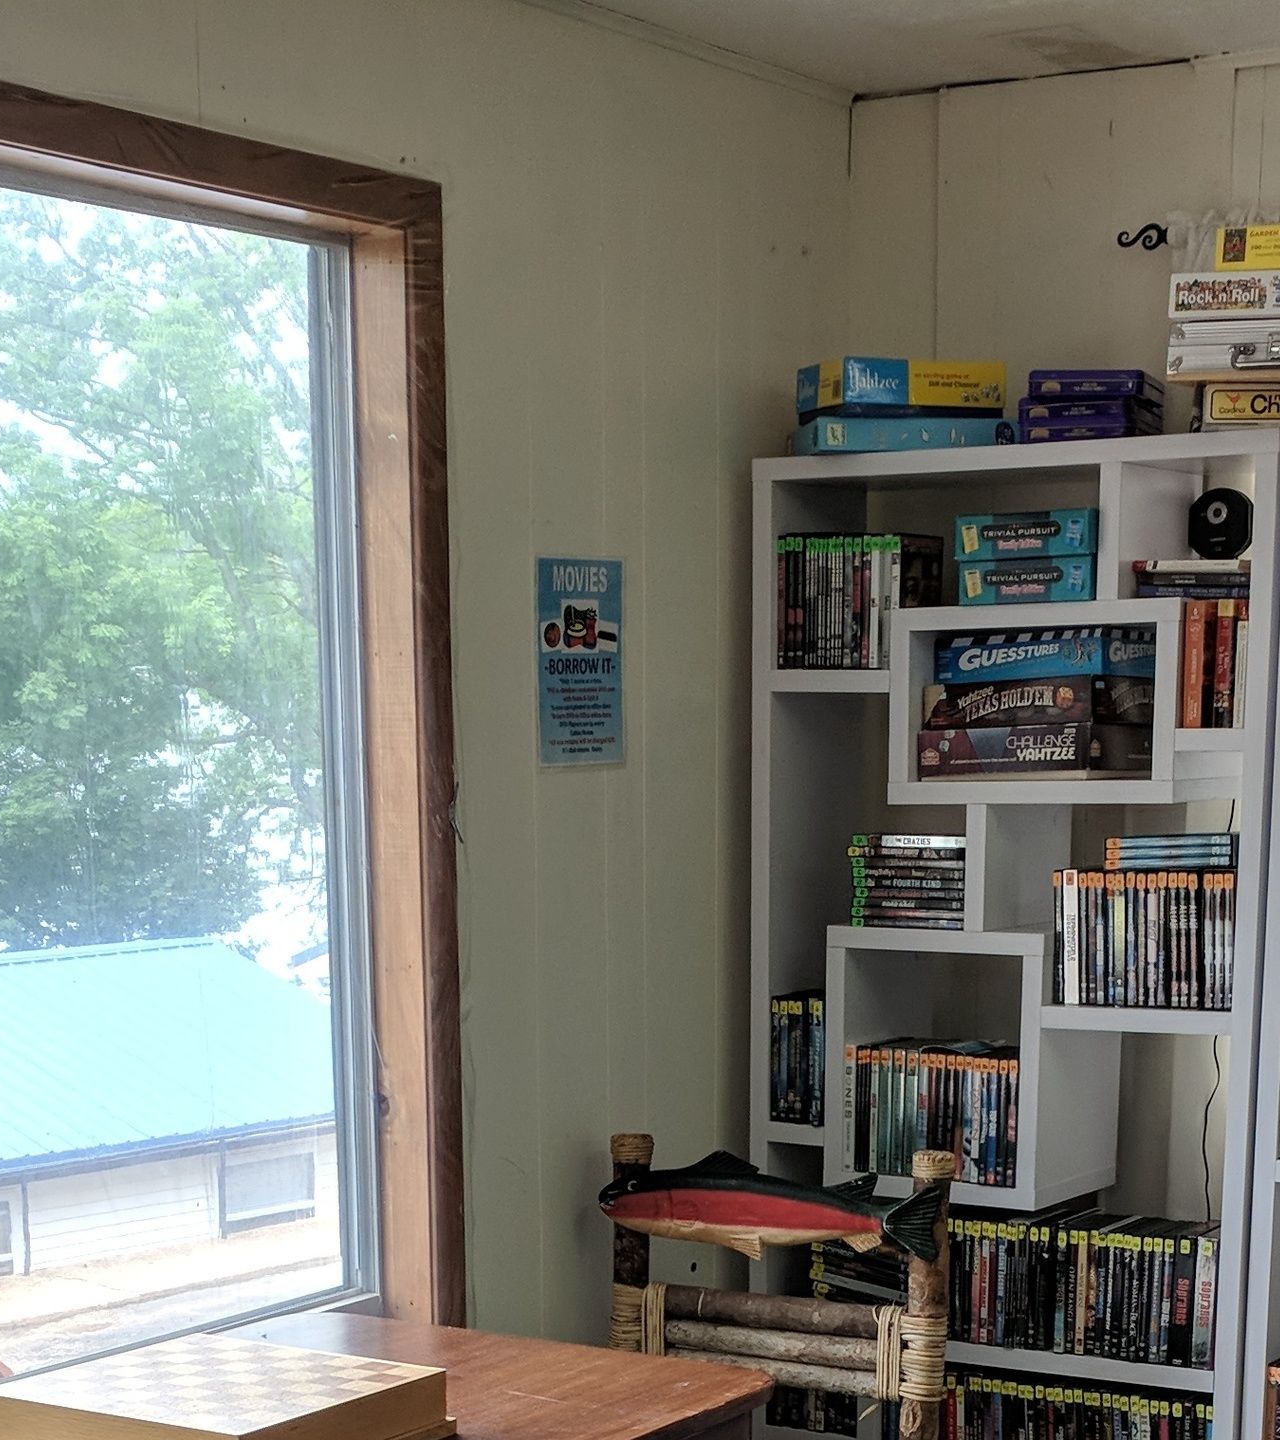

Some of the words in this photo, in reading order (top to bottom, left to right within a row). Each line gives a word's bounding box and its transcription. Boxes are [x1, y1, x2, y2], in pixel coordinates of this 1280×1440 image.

[1178, 290, 1214, 305] Rock
[1232, 288, 1260, 302] Roll
[983, 528, 1016, 539] TRIVIAL
[1018, 525, 1057, 536] PURSUIT
[553, 565, 608, 592] MOVIES
[986, 573, 1018, 583] TRIVIAL
[1020, 571, 1061, 581] PURSUIT
[958, 643, 1060, 671] GUESSTURES
[958, 685, 994, 709] Yahtzee
[965, 693, 1000, 723] TEXAS
[1006, 733, 1076, 749] CHALLENGE
[1016, 746, 1076, 761] YAHTZEE
